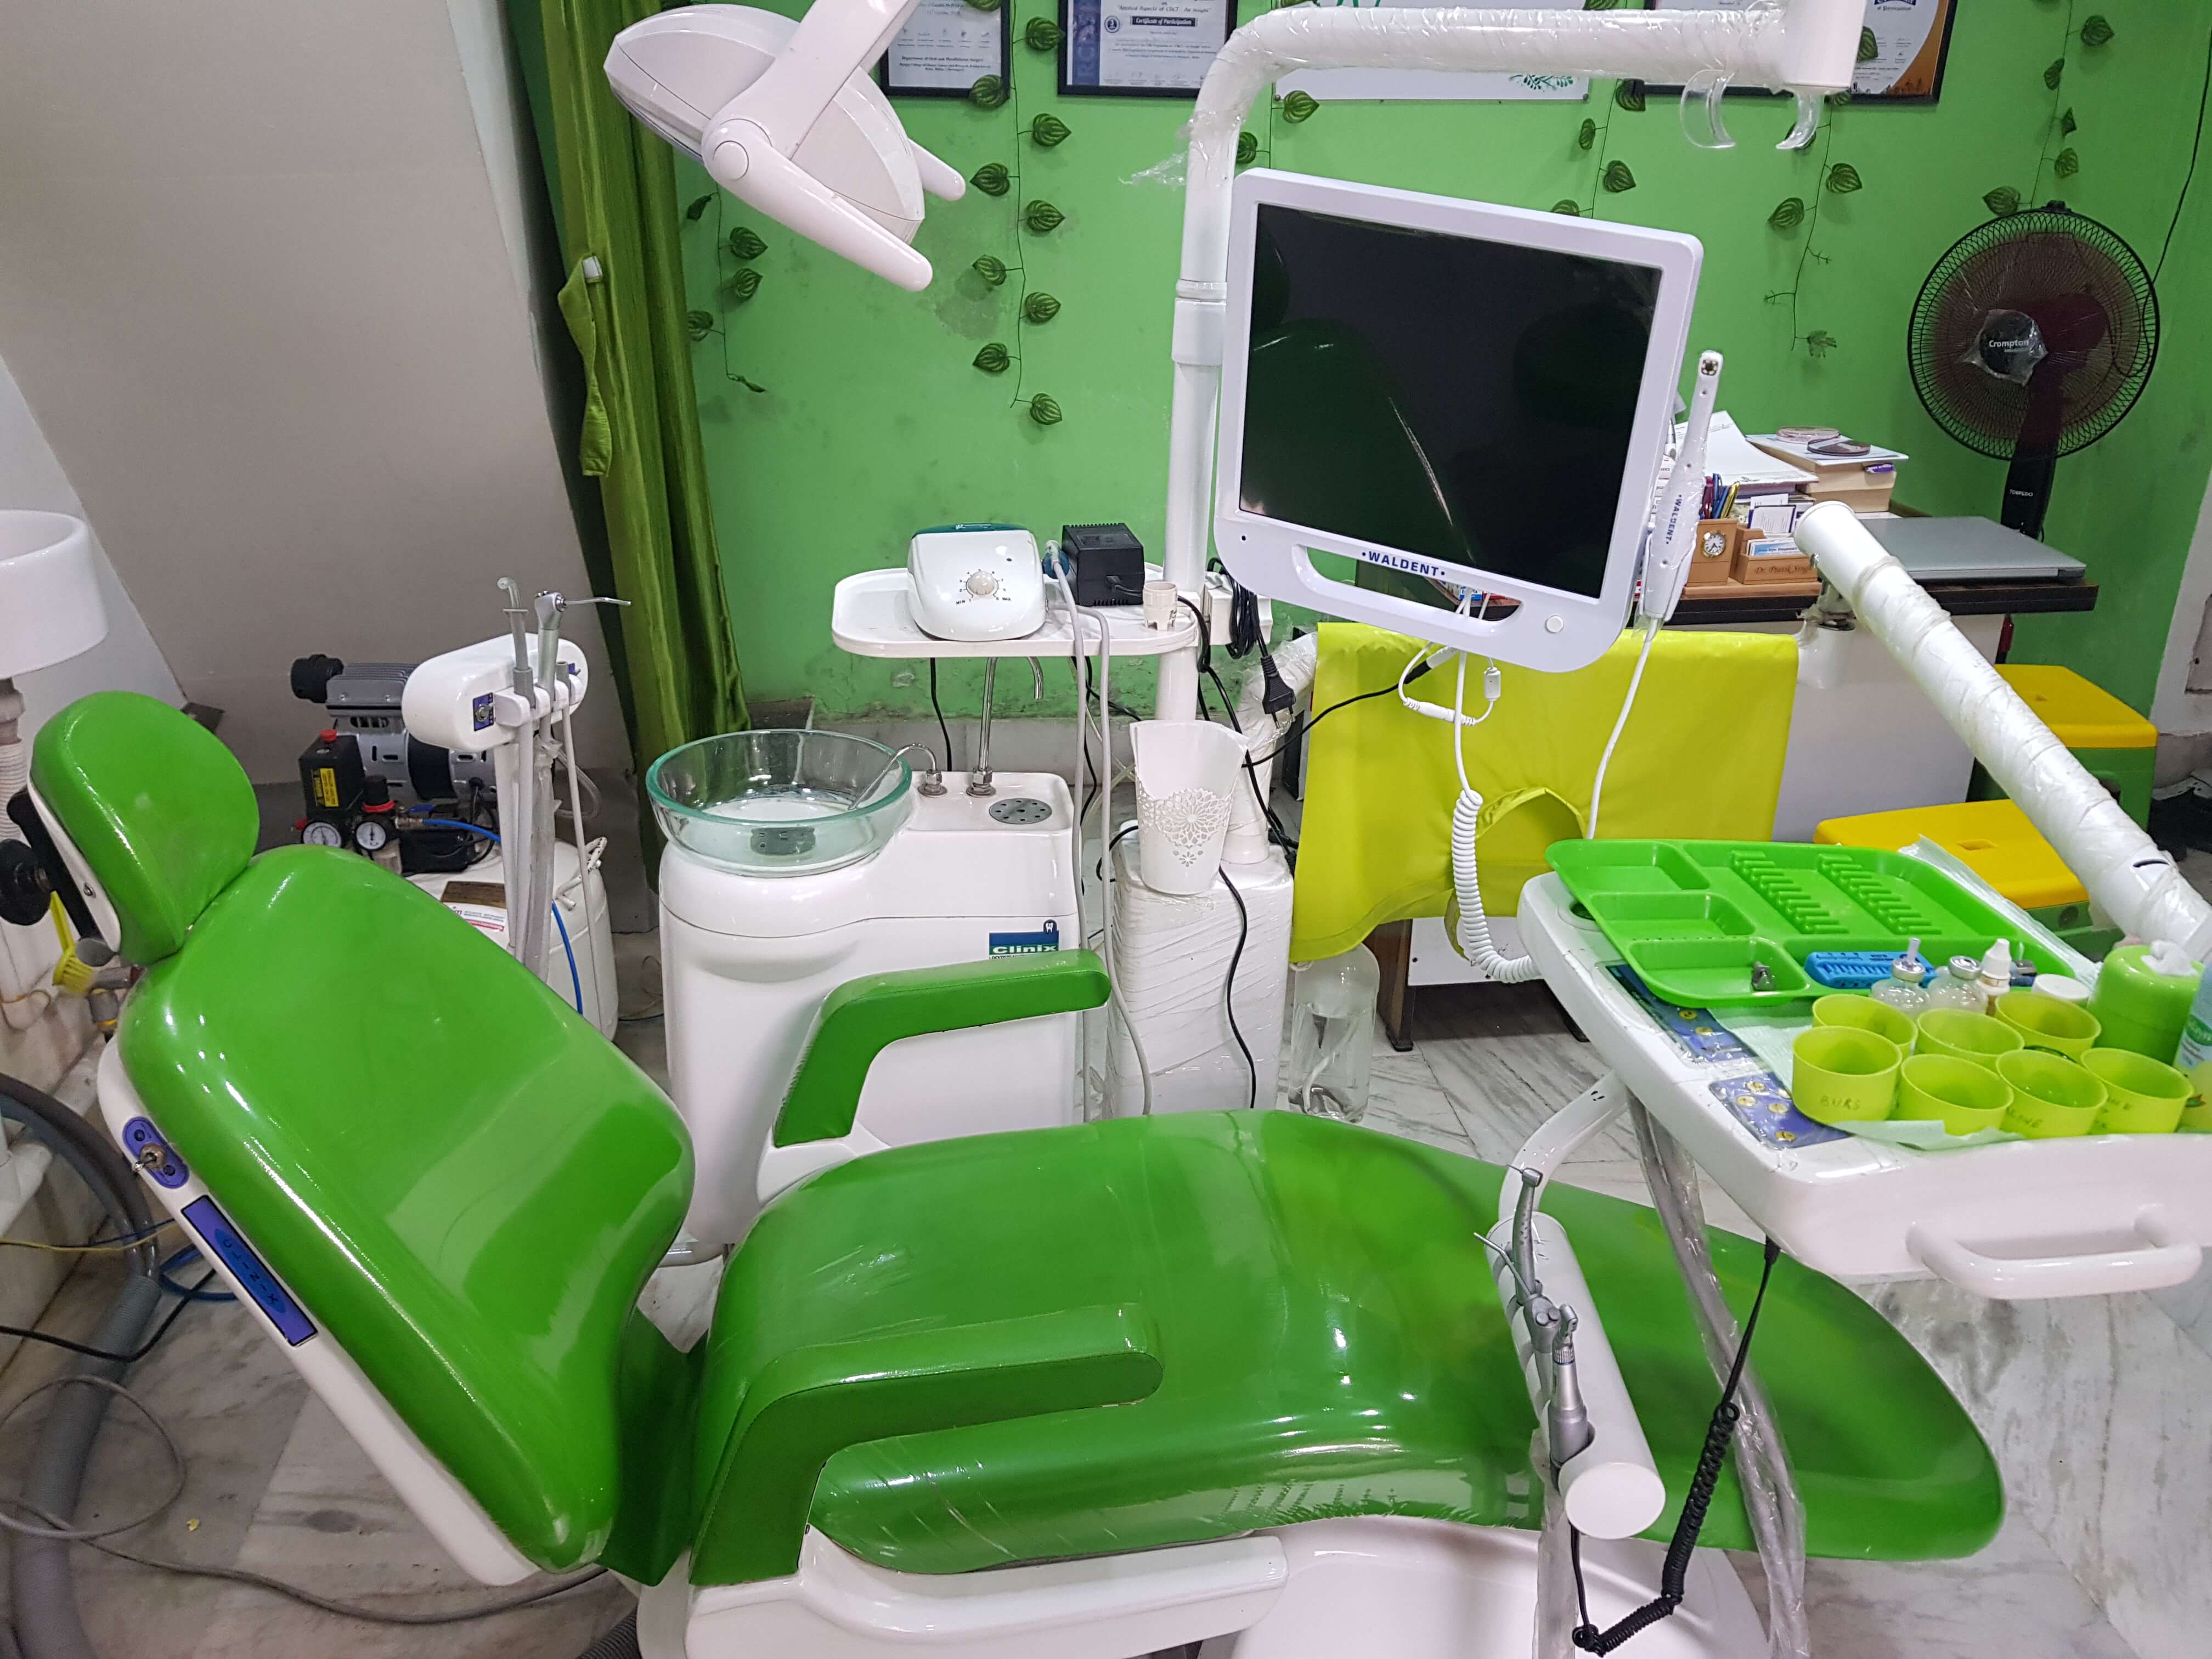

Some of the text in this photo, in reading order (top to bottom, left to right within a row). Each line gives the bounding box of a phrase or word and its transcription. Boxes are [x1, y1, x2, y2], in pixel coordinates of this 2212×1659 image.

[1666, 499, 1682, 541] WALDENT
[1369, 551, 1439, 576] WALDENT
[992, 944, 1057, 954] Clinix
